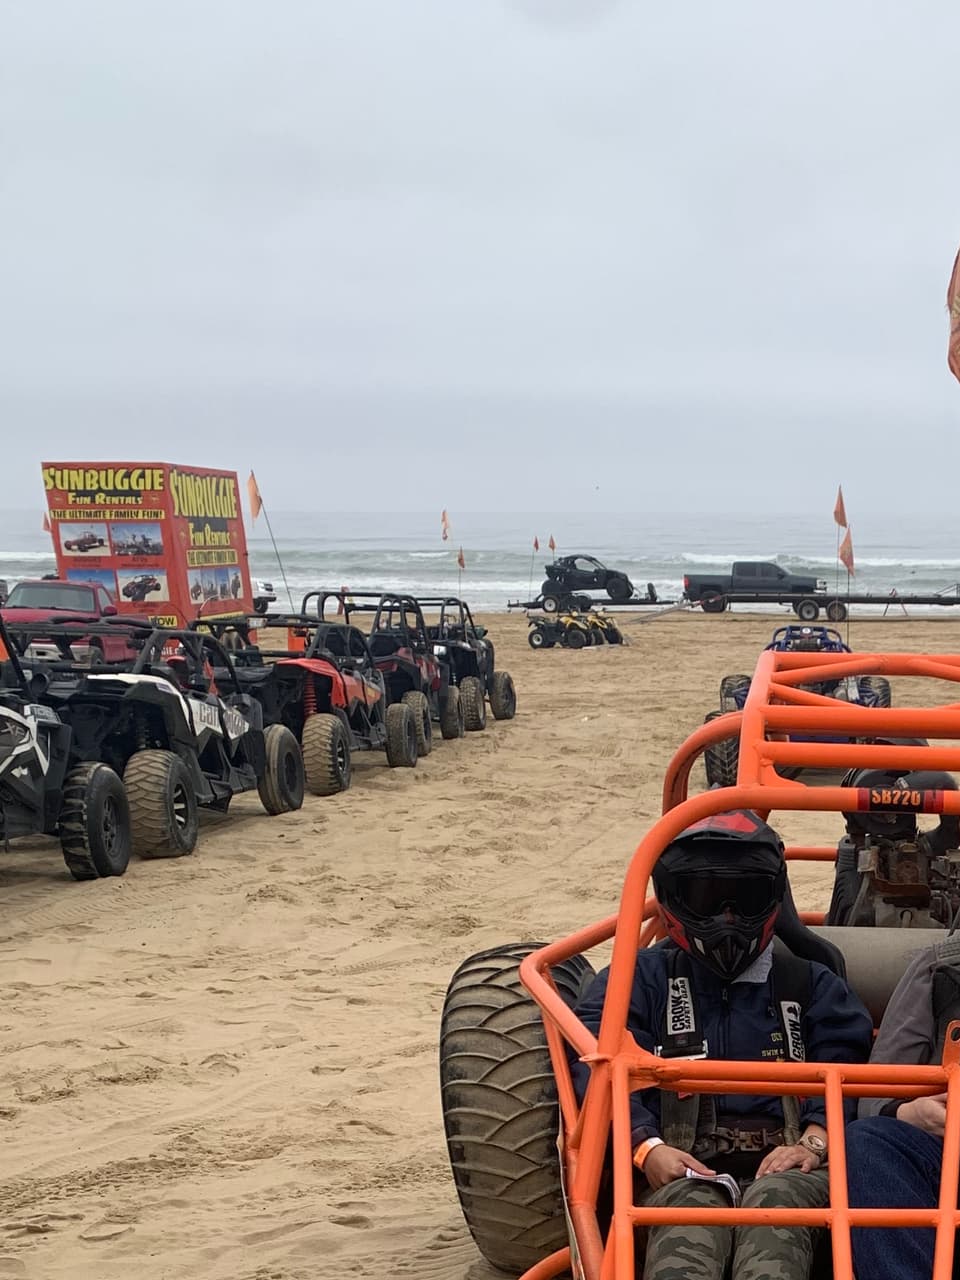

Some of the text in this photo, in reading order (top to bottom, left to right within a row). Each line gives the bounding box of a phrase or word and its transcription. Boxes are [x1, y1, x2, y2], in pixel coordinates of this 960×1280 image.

[43, 467, 164, 491] SUNBUGGIE
[170, 468, 237, 518] SUNBUGGIE
[671, 994, 685, 1032] CROW
[788, 1018, 802, 1060] CROW
